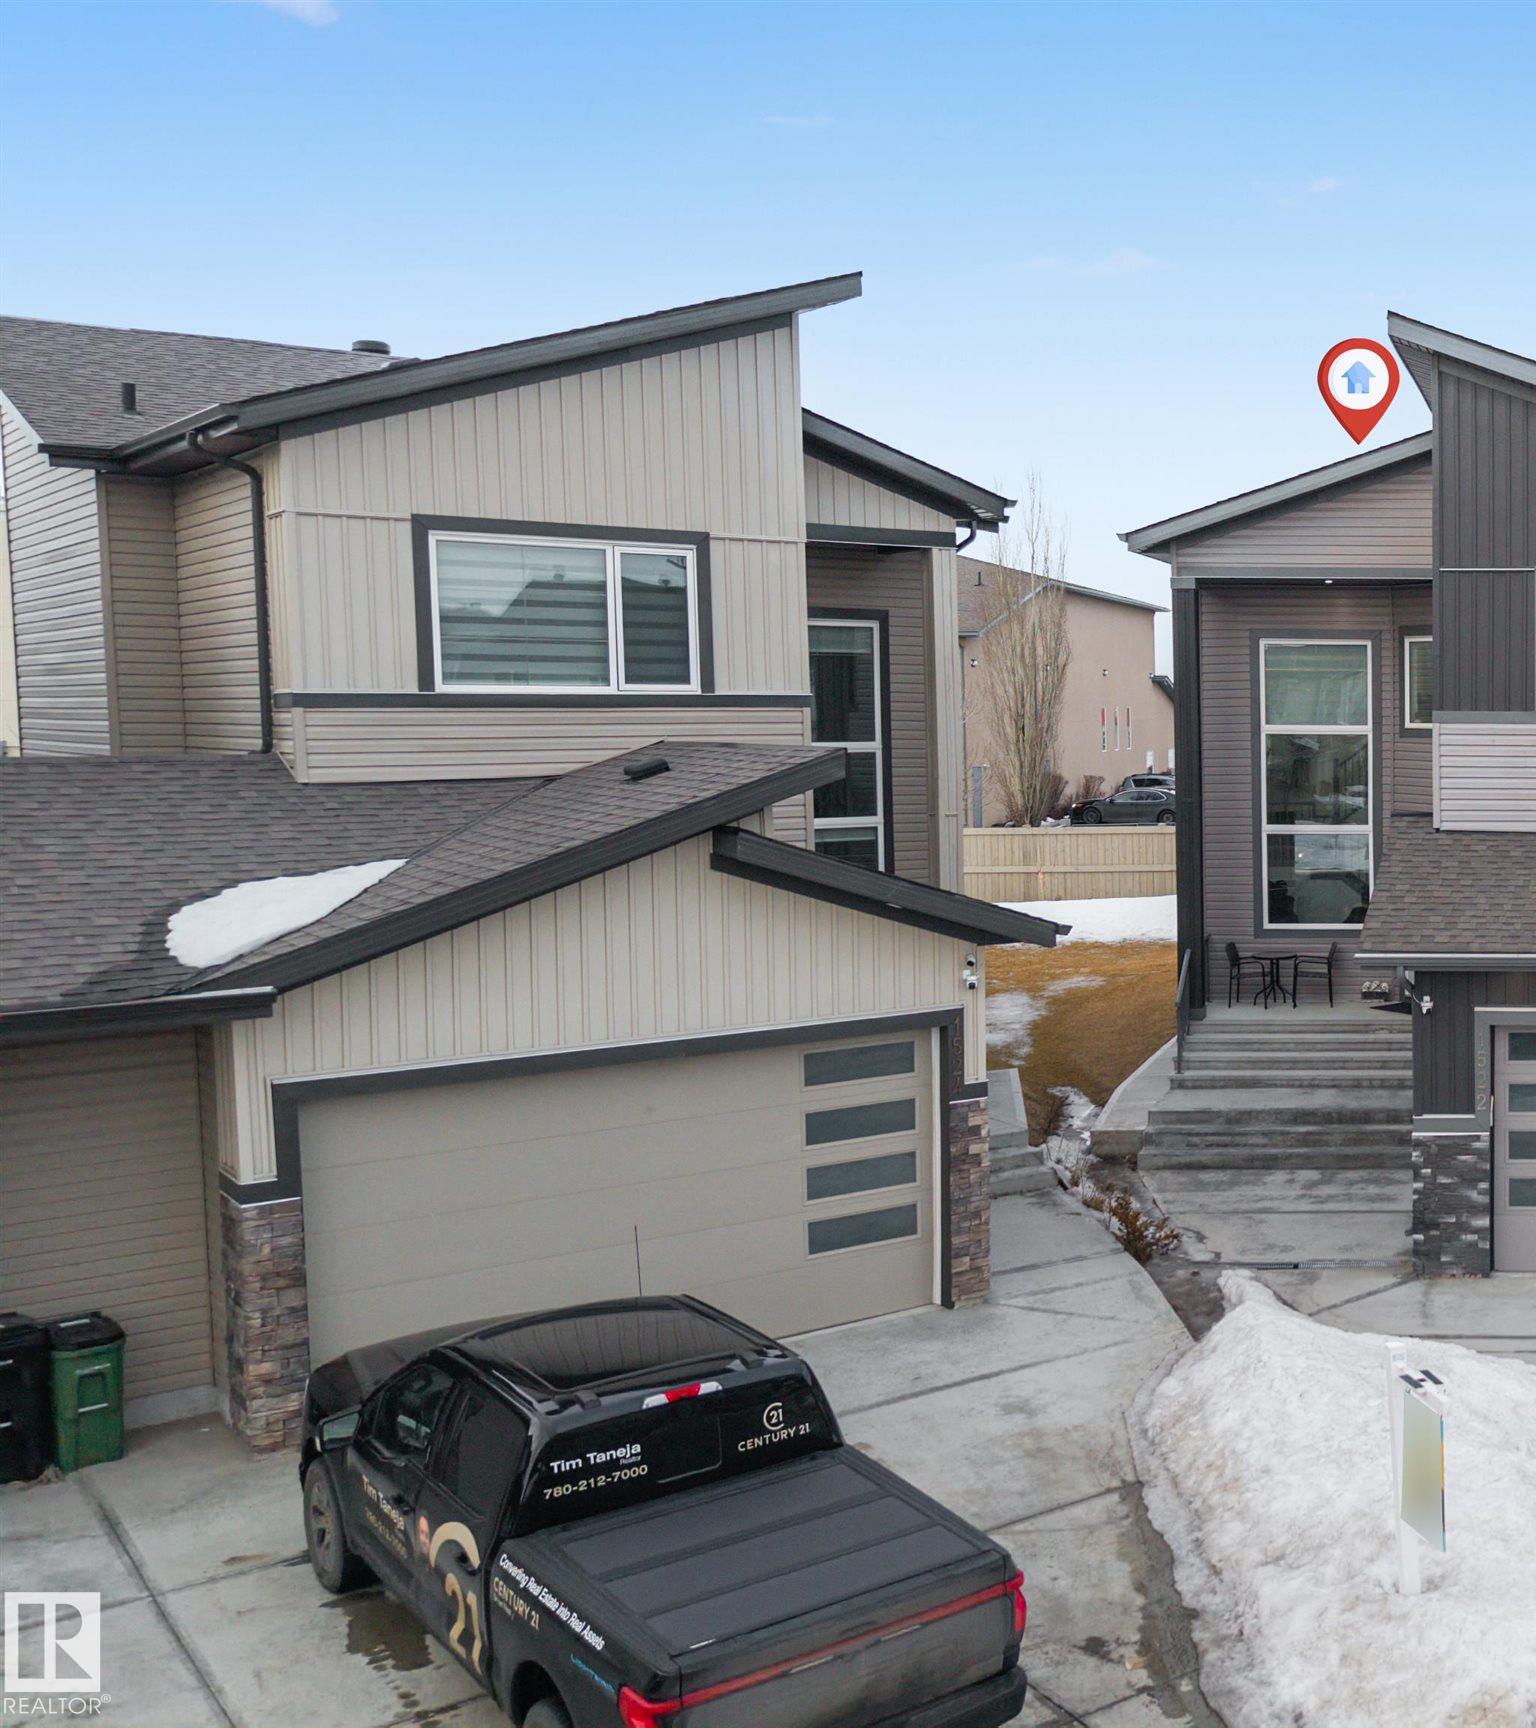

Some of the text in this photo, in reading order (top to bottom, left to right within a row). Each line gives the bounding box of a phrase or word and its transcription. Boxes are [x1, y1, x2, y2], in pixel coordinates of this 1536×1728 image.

[737, 1417, 810, 1452] CENTURY 21
[549, 1443, 642, 1474] Tim Taneja
[543, 1464, 648, 1500] 780-212-7000
[445, 1573, 483, 1676] 21
[493, 1576, 530, 1620] CENTURY
[530, 1611, 540, 1630] 21
[500, 1553, 529, 1588] Converting
[526, 1577, 543, 1596] Real
[538, 1587, 560, 1611] Estate
[567, 1612, 586, 1634] Real
[580, 1624, 605, 1651] Assets
